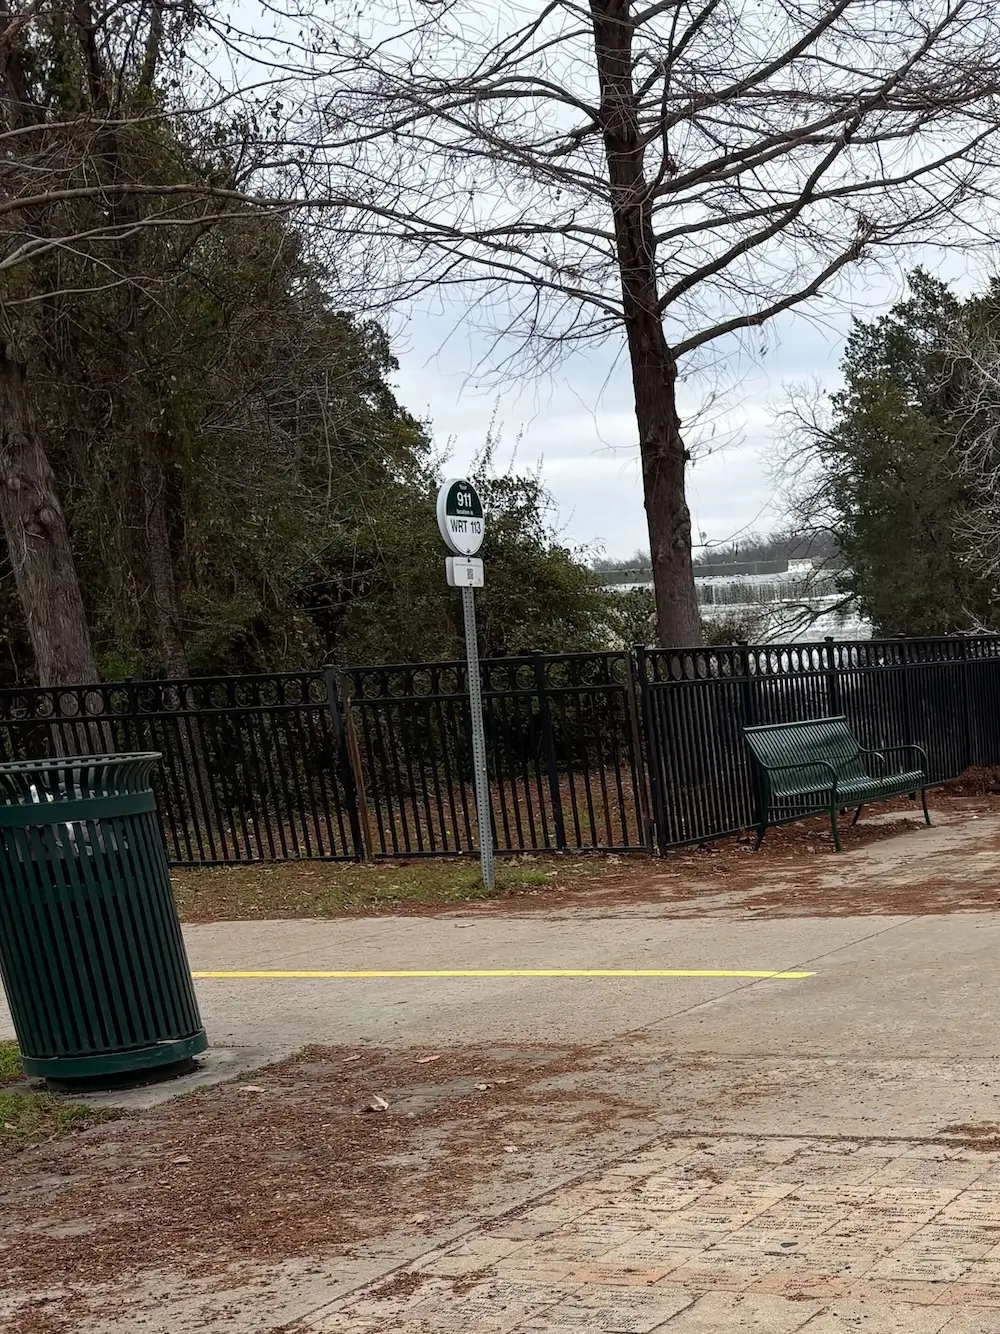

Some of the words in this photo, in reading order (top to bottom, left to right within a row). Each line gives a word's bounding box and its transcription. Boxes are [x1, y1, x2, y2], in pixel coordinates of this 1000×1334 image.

[456, 491, 472, 507] 911
[450, 520, 468, 533] WRT
[471, 521, 482, 535] 113
